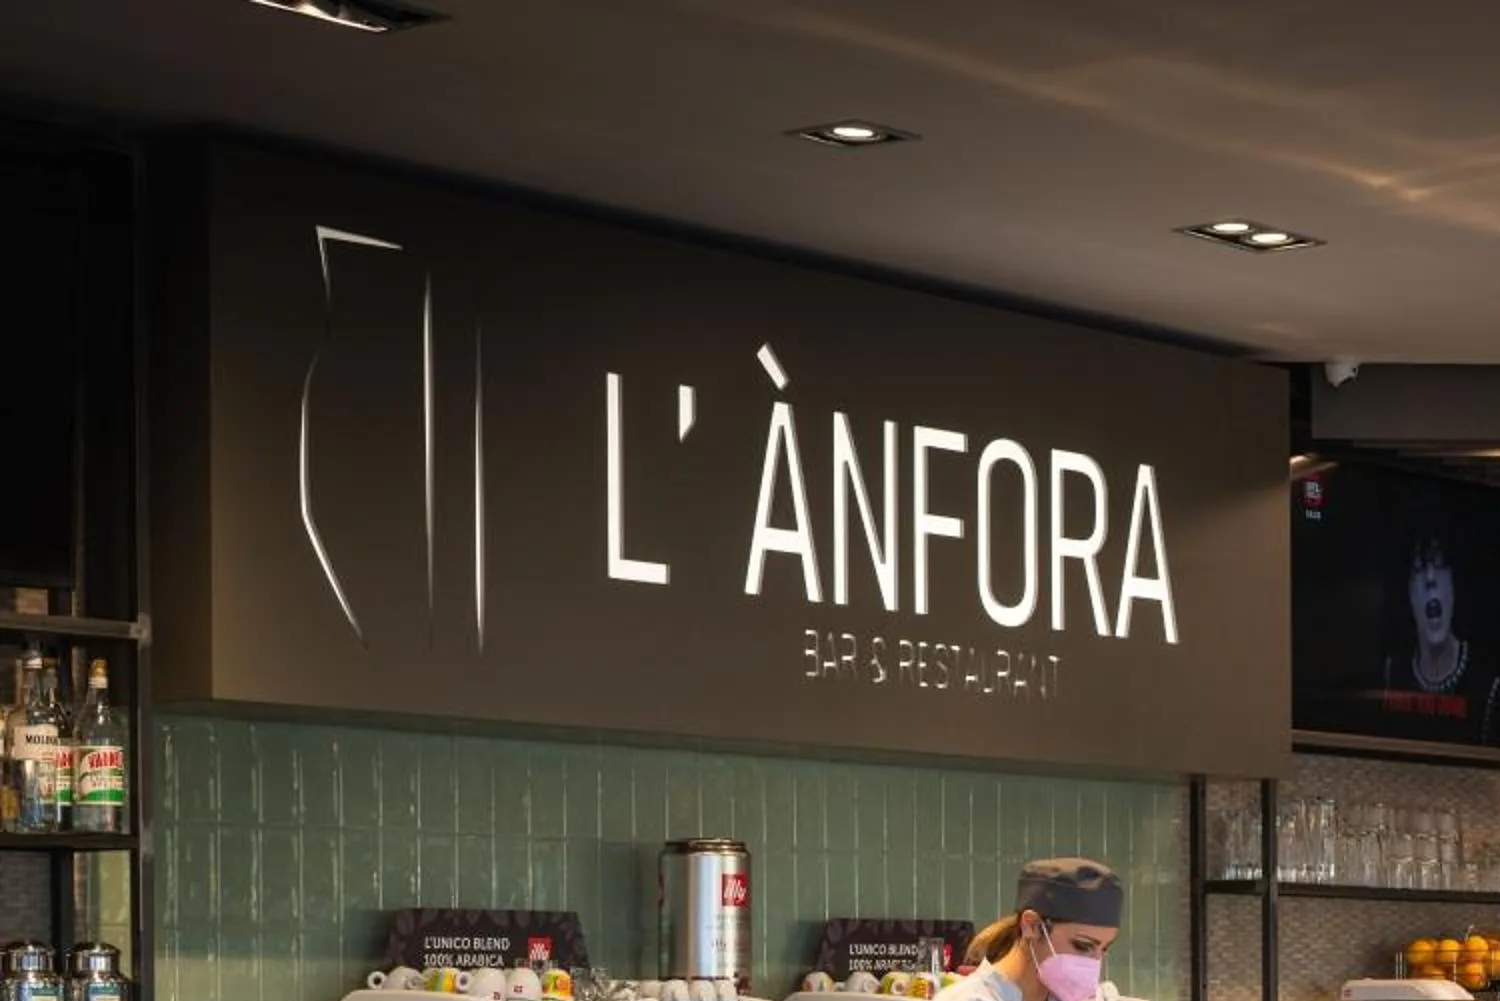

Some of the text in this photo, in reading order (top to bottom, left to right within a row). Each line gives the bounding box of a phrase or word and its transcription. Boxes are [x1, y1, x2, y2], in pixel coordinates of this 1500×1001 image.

[424, 936, 511, 950] L'UNICO BLEND
[423, 953, 505, 967] 100% ARABICA
